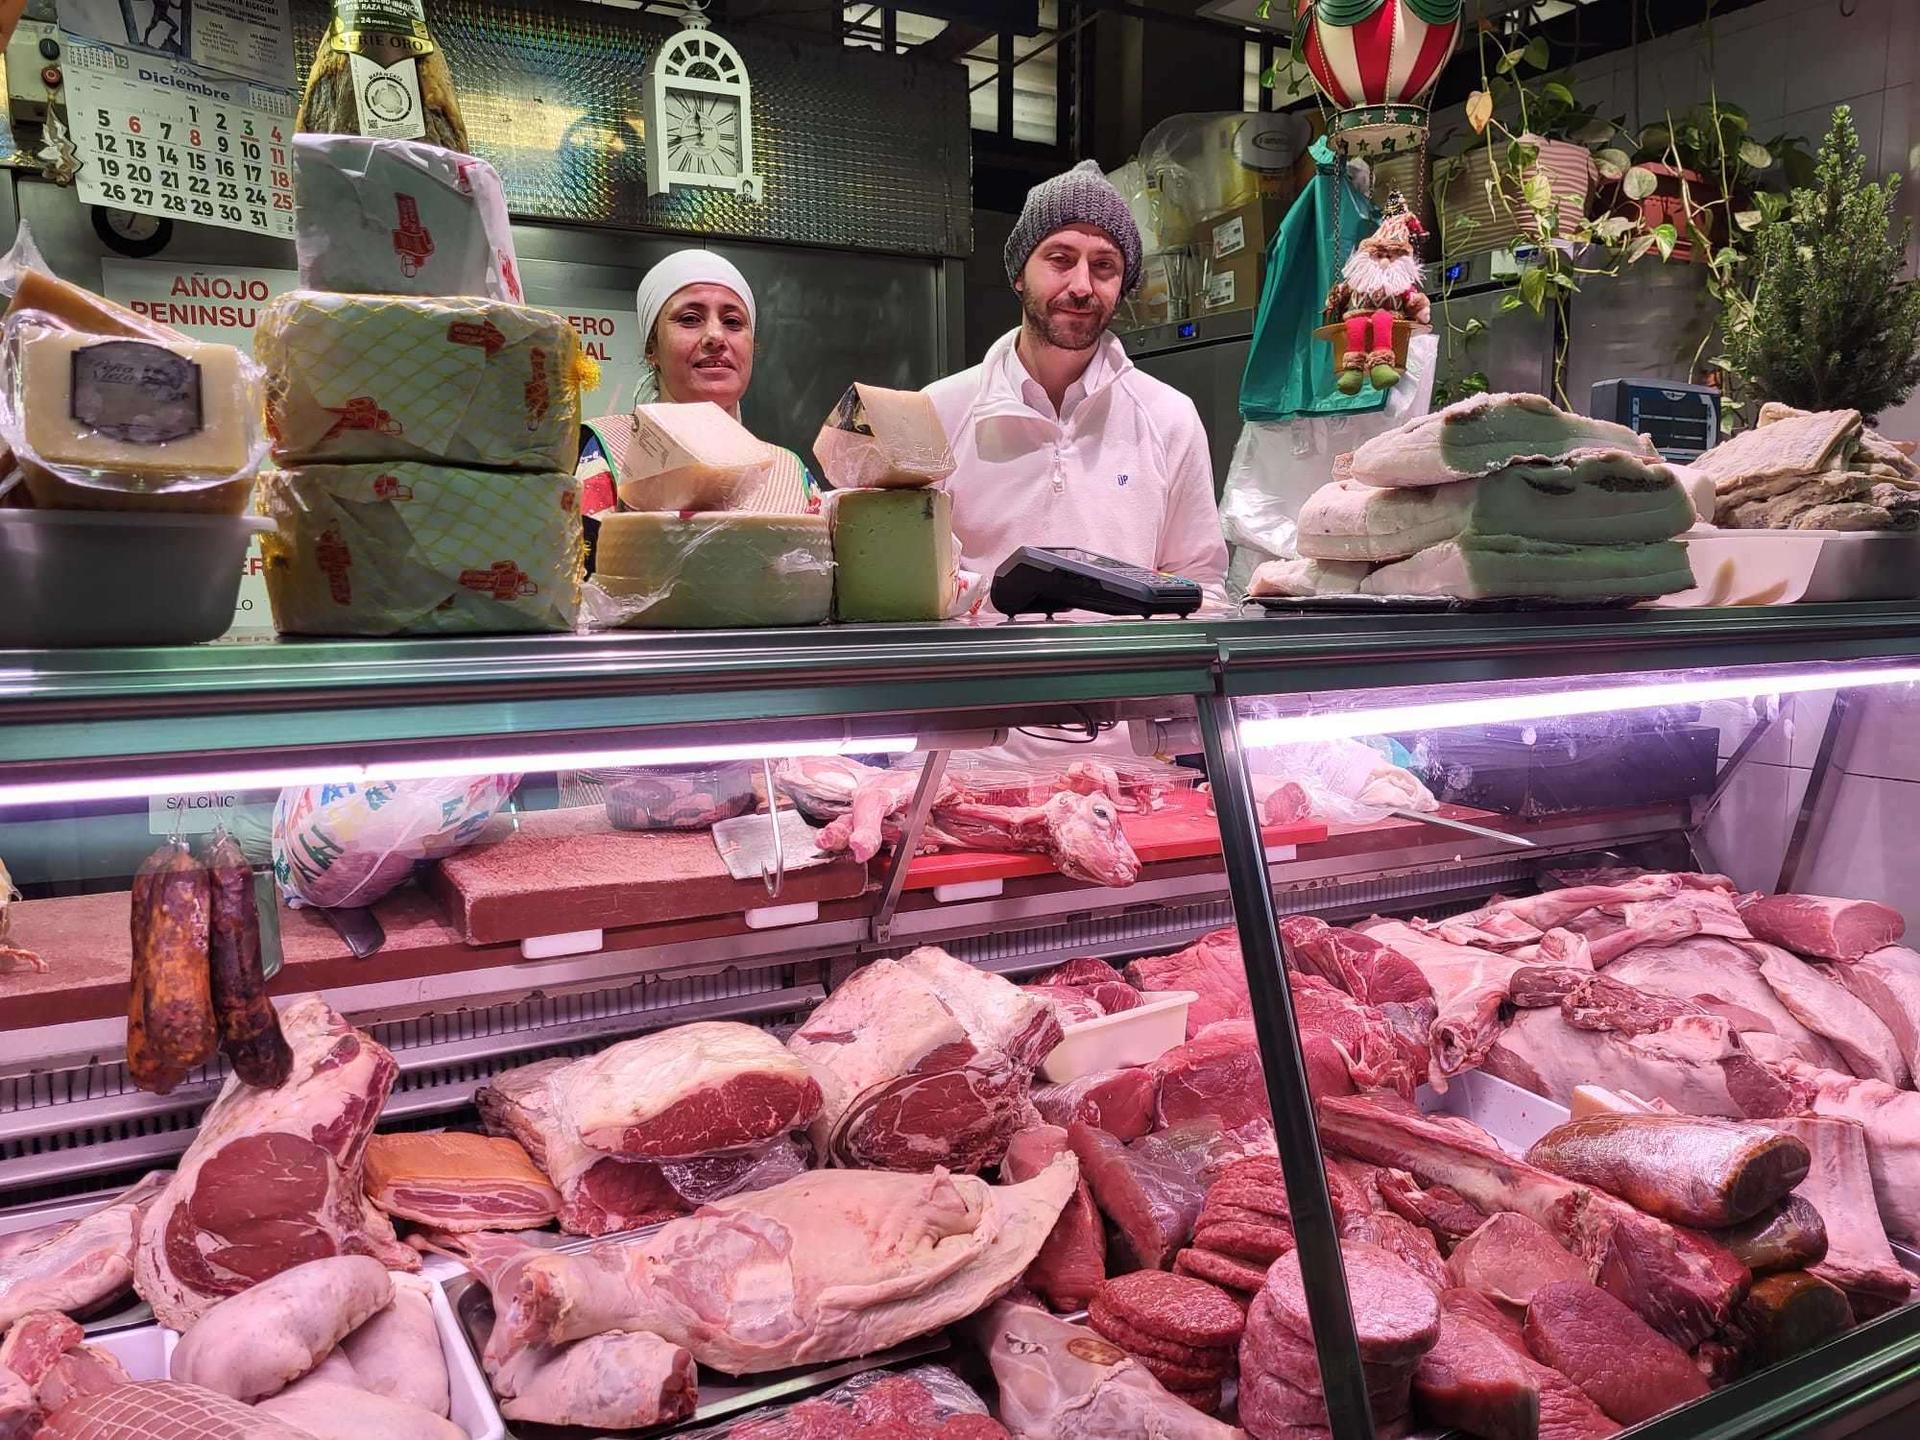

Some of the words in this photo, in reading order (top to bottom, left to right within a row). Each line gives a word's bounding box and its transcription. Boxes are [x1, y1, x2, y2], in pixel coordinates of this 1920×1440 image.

[389, 36, 423, 51] ORO
[138, 68, 230, 101] Diciembre
[98, 109, 111, 127] 5
[128, 115, 141, 133] 6
[160, 122, 172, 139] 7
[189, 129, 202, 146] 8
[217, 136, 229, 153] 9
[240, 142, 261, 160] 10
[270, 148, 285, 165] 11
[188, 105, 197, 122] 1
[216, 113, 227, 131] 2
[243, 119, 254, 136] 3
[271, 126, 282, 143] 4
[95, 132, 117, 153] 12
[126, 139, 147, 159] 13
[157, 145, 179, 165] 14
[187, 152, 207, 171] 15
[216, 159, 235, 177] 16
[244, 165, 262, 182] 17
[270, 170, 289, 188] 18
[98, 157, 120, 177] 19
[126, 163, 152, 183] 20
[160, 170, 179, 189] 21
[188, 176, 211, 195] 22
[217, 181, 239, 200] 23
[245, 187, 267, 205] 24
[272, 193, 293, 210] 25
[100, 181, 126, 201] 26
[131, 187, 153, 206] 27
[161, 193, 186, 212] 28
[191, 199, 213, 217] 29
[219, 204, 242, 222] 30
[250, 210, 268, 227] 31
[171, 271, 269, 301] AÑOJO
